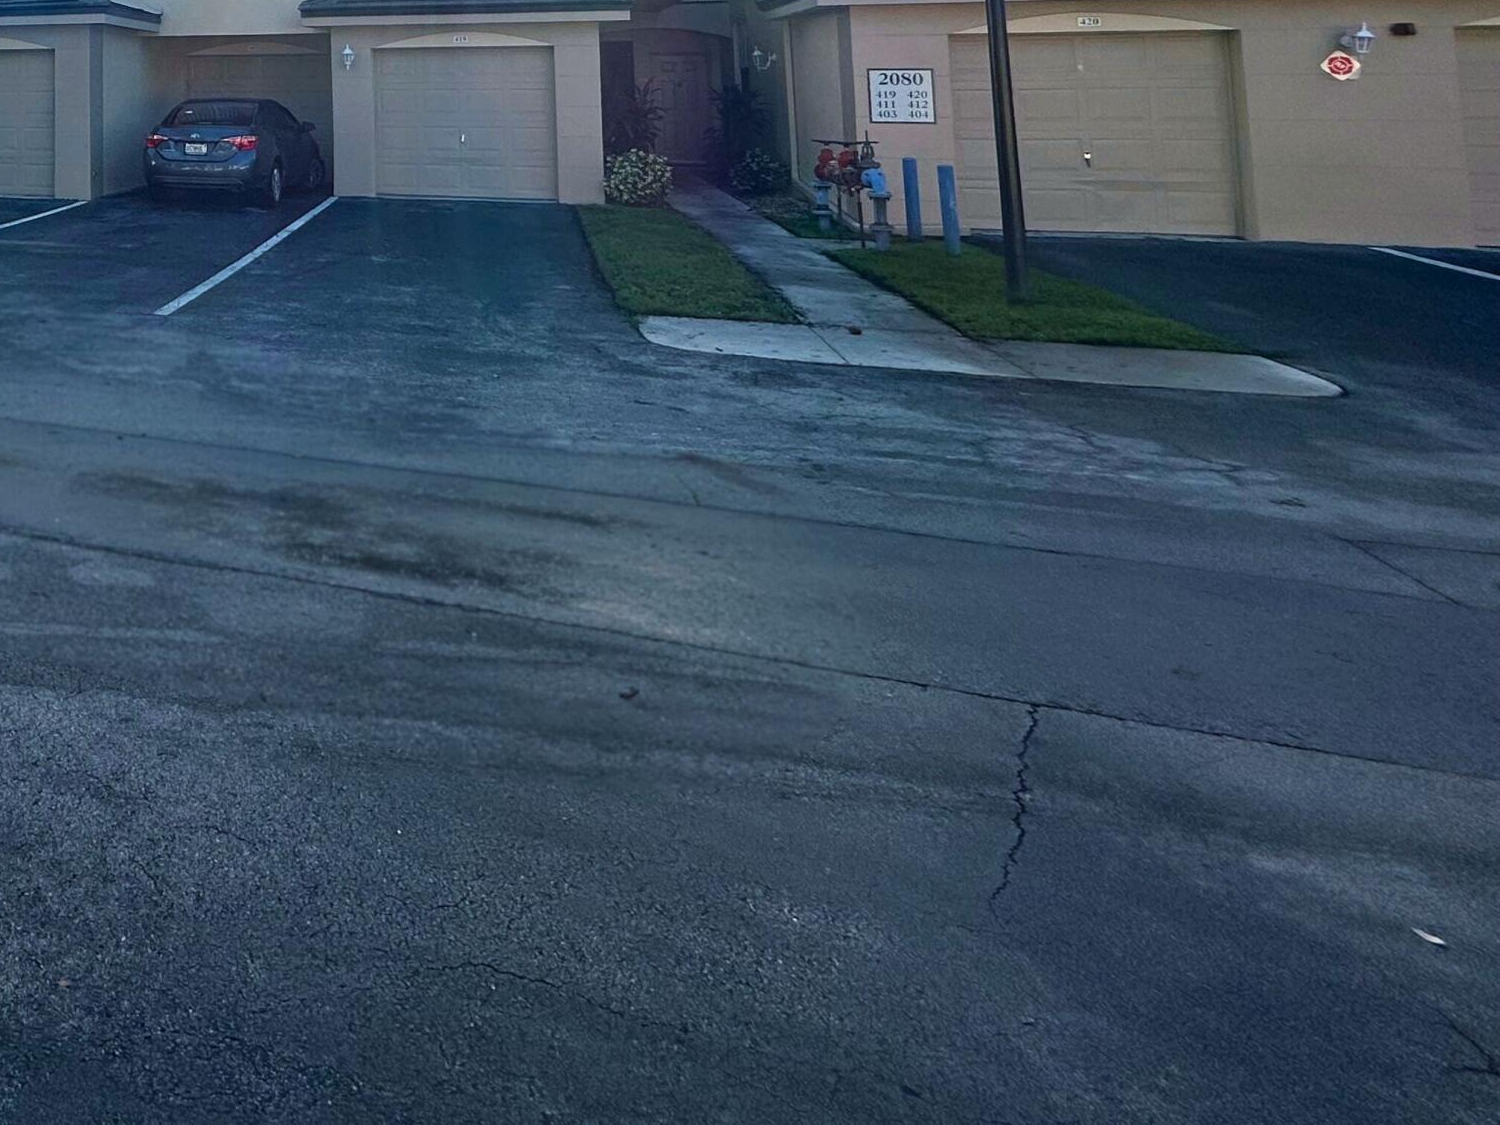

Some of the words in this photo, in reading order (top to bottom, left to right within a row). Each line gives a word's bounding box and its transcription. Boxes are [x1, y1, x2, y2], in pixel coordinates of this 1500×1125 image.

[1079, 17, 1100, 26] 420
[878, 72, 924, 86] 2080
[876, 90, 897, 99] 419
[907, 90, 928, 99] 420
[876, 100, 896, 109] 411
[908, 100, 929, 109] 412
[877, 110, 898, 119] 403
[908, 110, 929, 119] 404
